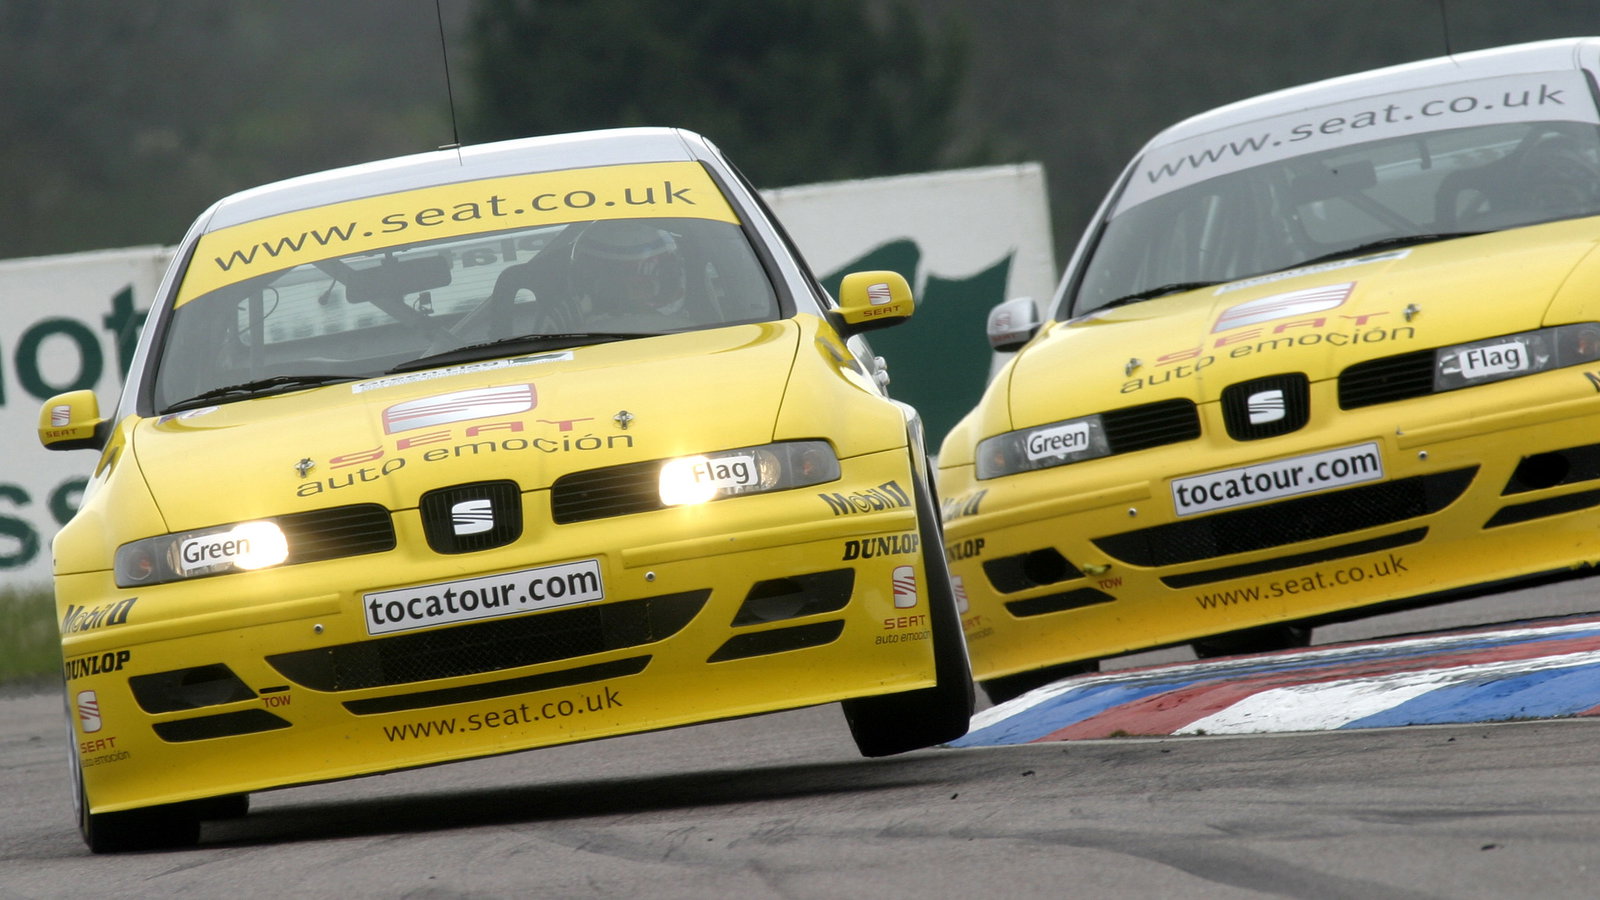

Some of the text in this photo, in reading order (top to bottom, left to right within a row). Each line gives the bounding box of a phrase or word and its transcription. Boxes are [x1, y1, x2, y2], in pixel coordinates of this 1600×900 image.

[1146, 84, 1565, 184] www.seat.co.uk
[214, 181, 696, 271] www.seat.co.uk
[863, 304, 901, 317] SEAT
[1154, 311, 1390, 367] SEAT
[1119, 327, 1415, 394] auto emoción
[1466, 348, 1521, 370] Flag
[46, 428, 78, 438] SEAT
[329, 417, 596, 471] SEAT
[1029, 431, 1086, 455] Green
[297, 434, 633, 497] auto emoción
[691, 461, 750, 484] Flag
[1176, 452, 1378, 507] tocatour.com
[183, 538, 250, 564] Green
[842, 533, 919, 561] DUNLOP
[946, 538, 985, 562] NLOP
[1098, 576, 1123, 590] TOW
[1196, 553, 1408, 610] www.seat.co.uk
[369, 570, 598, 625] tocatour.com
[884, 615, 926, 630] SEAT
[875, 633, 899, 646] auto
[65, 650, 130, 681] DUNLOP
[262, 695, 291, 709] TOW
[384, 687, 623, 742] www.seat.co.uk
[80, 736, 117, 754] SEAT
